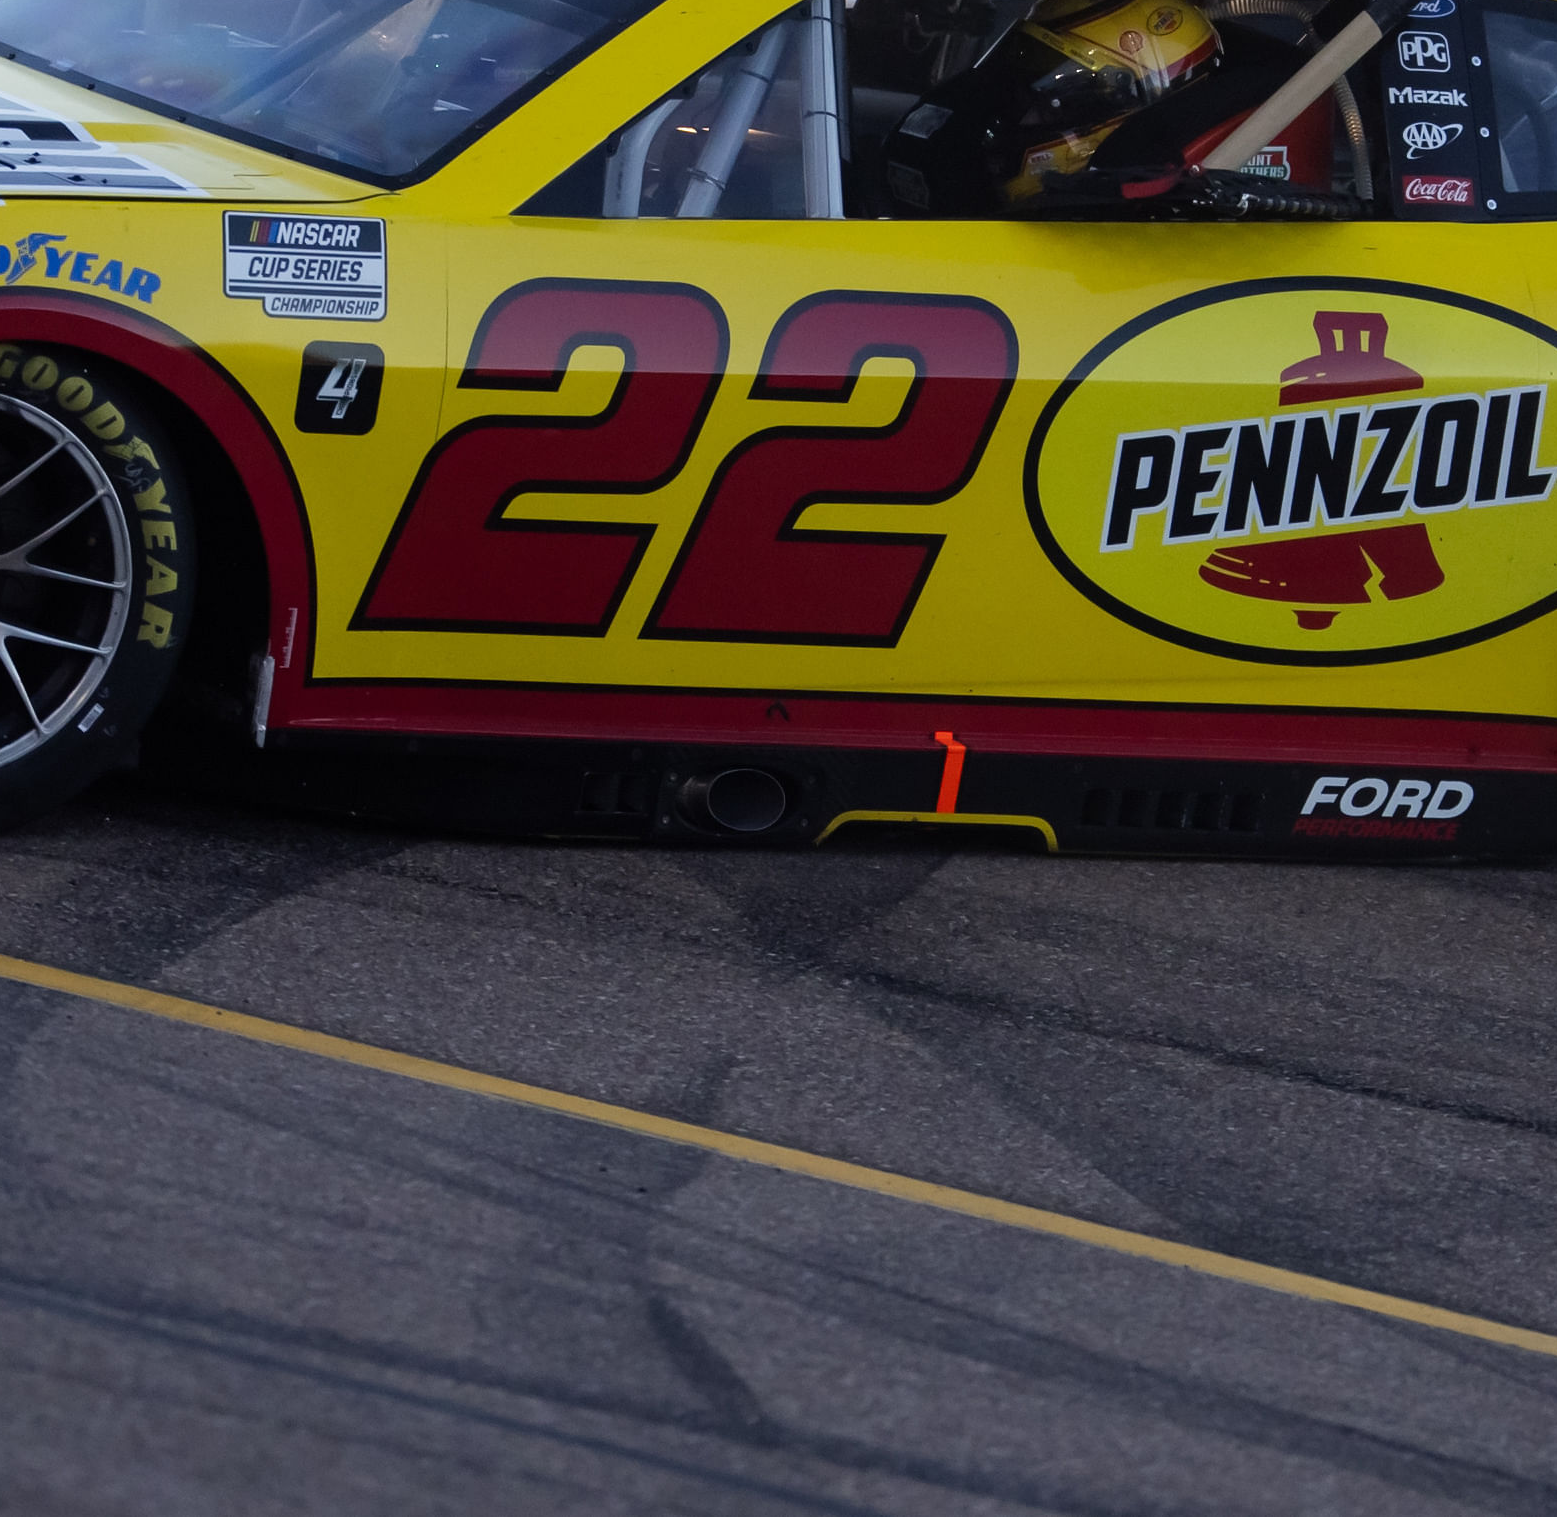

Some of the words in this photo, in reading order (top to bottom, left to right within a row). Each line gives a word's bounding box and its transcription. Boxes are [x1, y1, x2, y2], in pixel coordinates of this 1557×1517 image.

[1403, 36, 1446, 66] PPG
[1388, 87, 1468, 106] Mazak
[1408, 124, 1445, 146] AAA
[276, 221, 360, 248] NASCAR
[248, 256, 289, 279] CUP
[291, 258, 363, 282] SERIES
[271, 296, 380, 316] CHAMPIONSHIP
[316, 358, 367, 419] 4
[347, 277, 1020, 649] 22
[1300, 776, 1475, 819] FORD
[1293, 818, 1459, 841] PERFORMANCE
